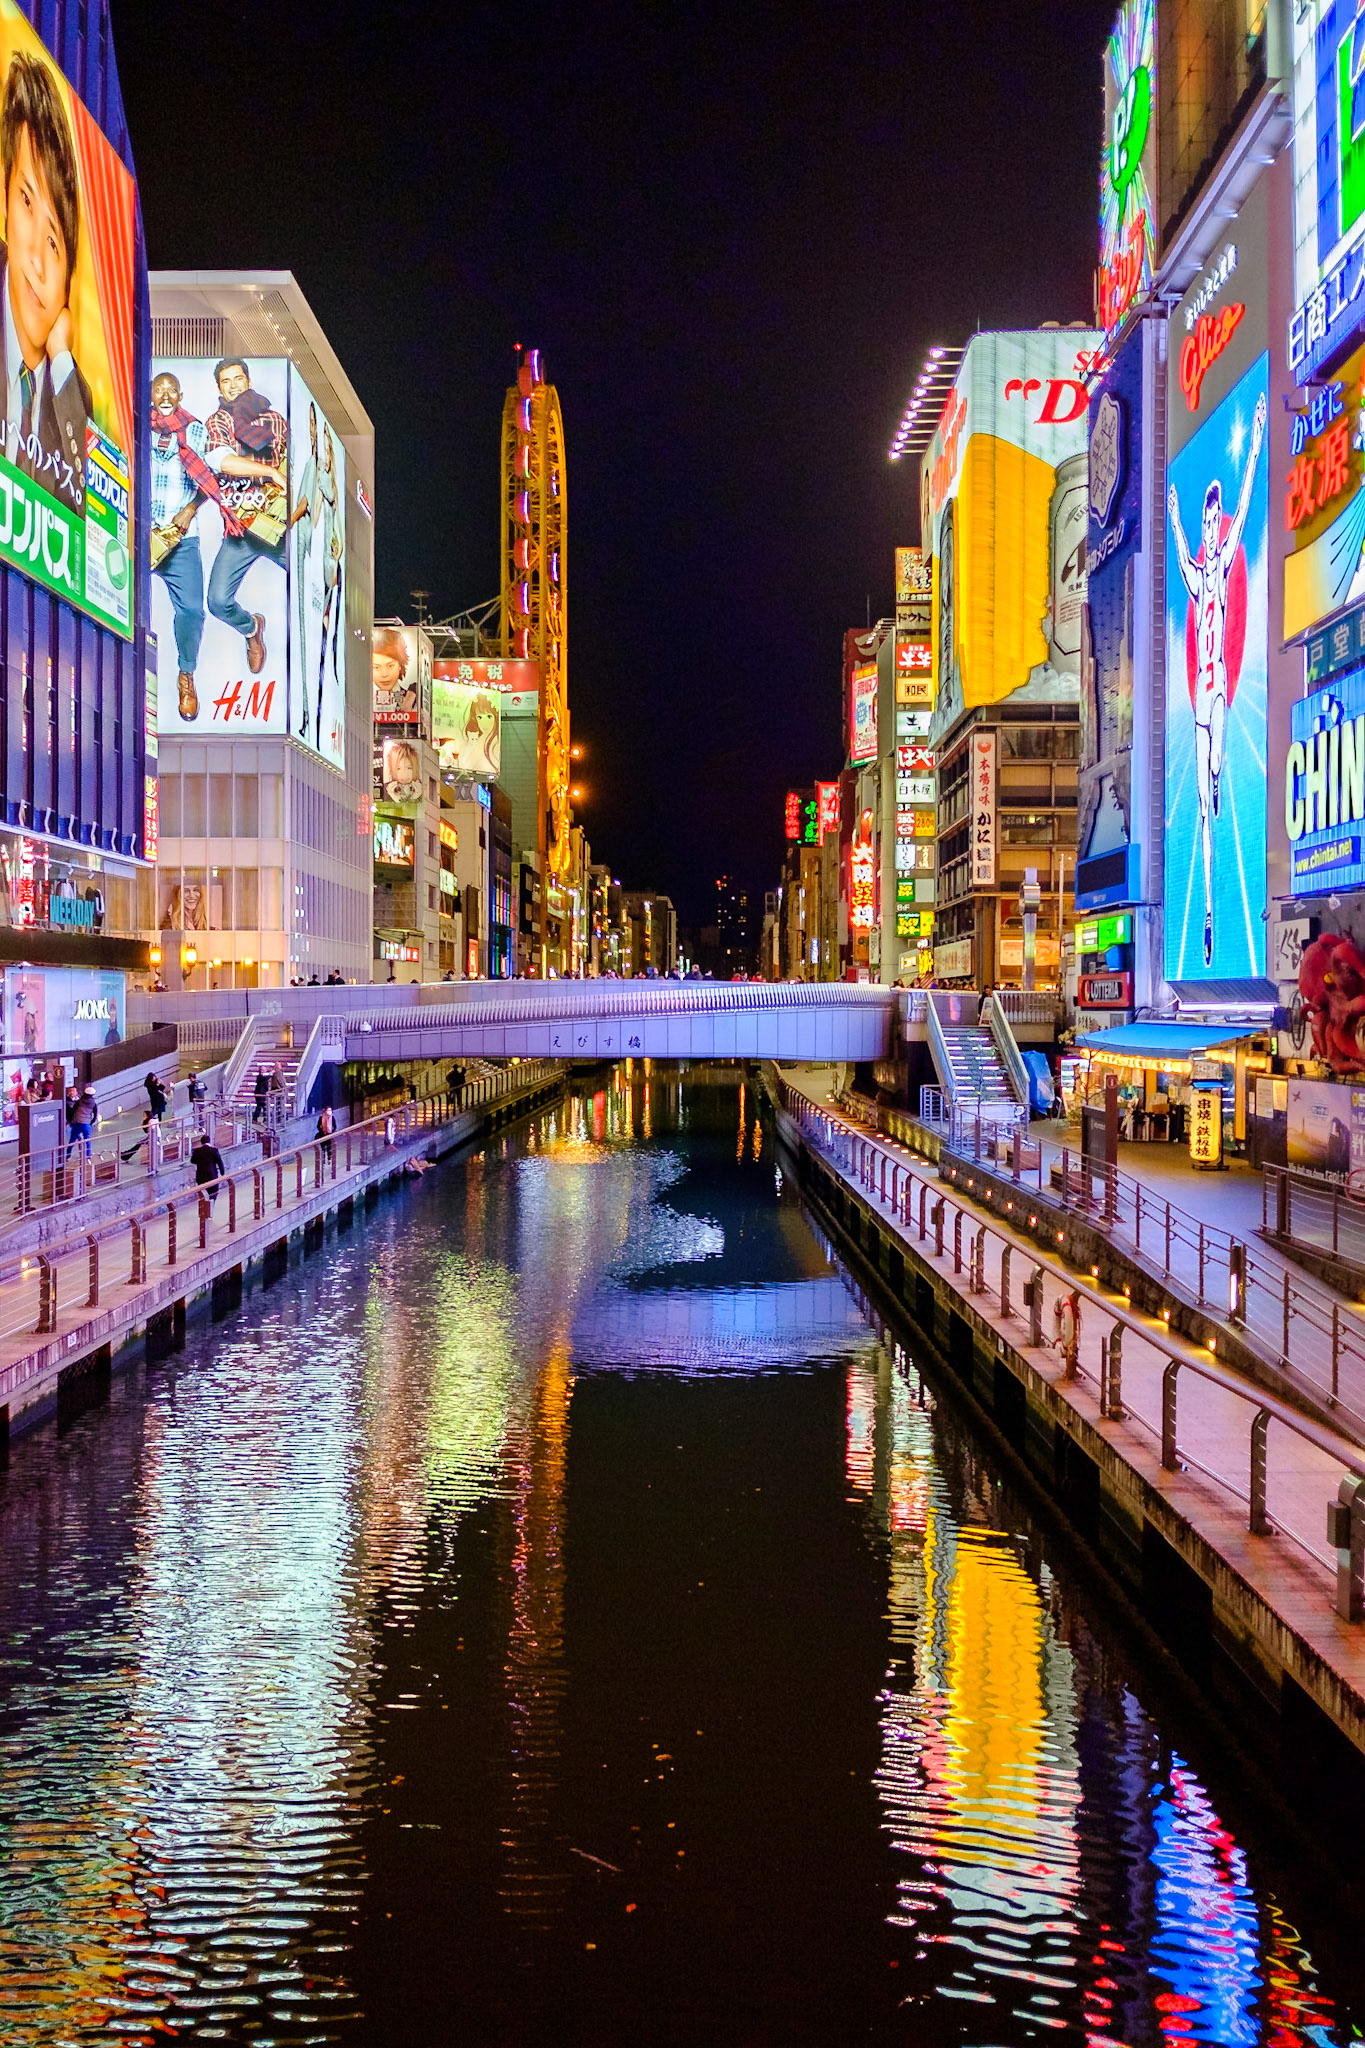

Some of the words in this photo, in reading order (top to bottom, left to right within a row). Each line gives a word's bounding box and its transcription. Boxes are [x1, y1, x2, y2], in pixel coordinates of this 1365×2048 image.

[1180, 302, 1245, 412] Glico
[1291, 381, 1344, 456] かぜに
[1285, 417, 1349, 531] 改源
[219, 478, 252, 491] シャツ
[220, 491, 266, 511] ¥999
[1205, 594, 1215, 693] グリコ
[906, 685, 927, 696] 和民
[213, 681, 276, 721] H&M
[898, 770, 912, 778] 4F
[900, 783, 931, 795] 白木屋
[898, 804, 911, 812] 3F
[898, 837, 911, 845] 2F
[898, 870, 911, 878] 1F
[49, 894, 94, 927] WEEKDAY
[1090, 981, 1119, 998] LOTTERIA
[74, 998, 110, 1020] MONKI
[553, 1035, 641, 1049] えびす橋
